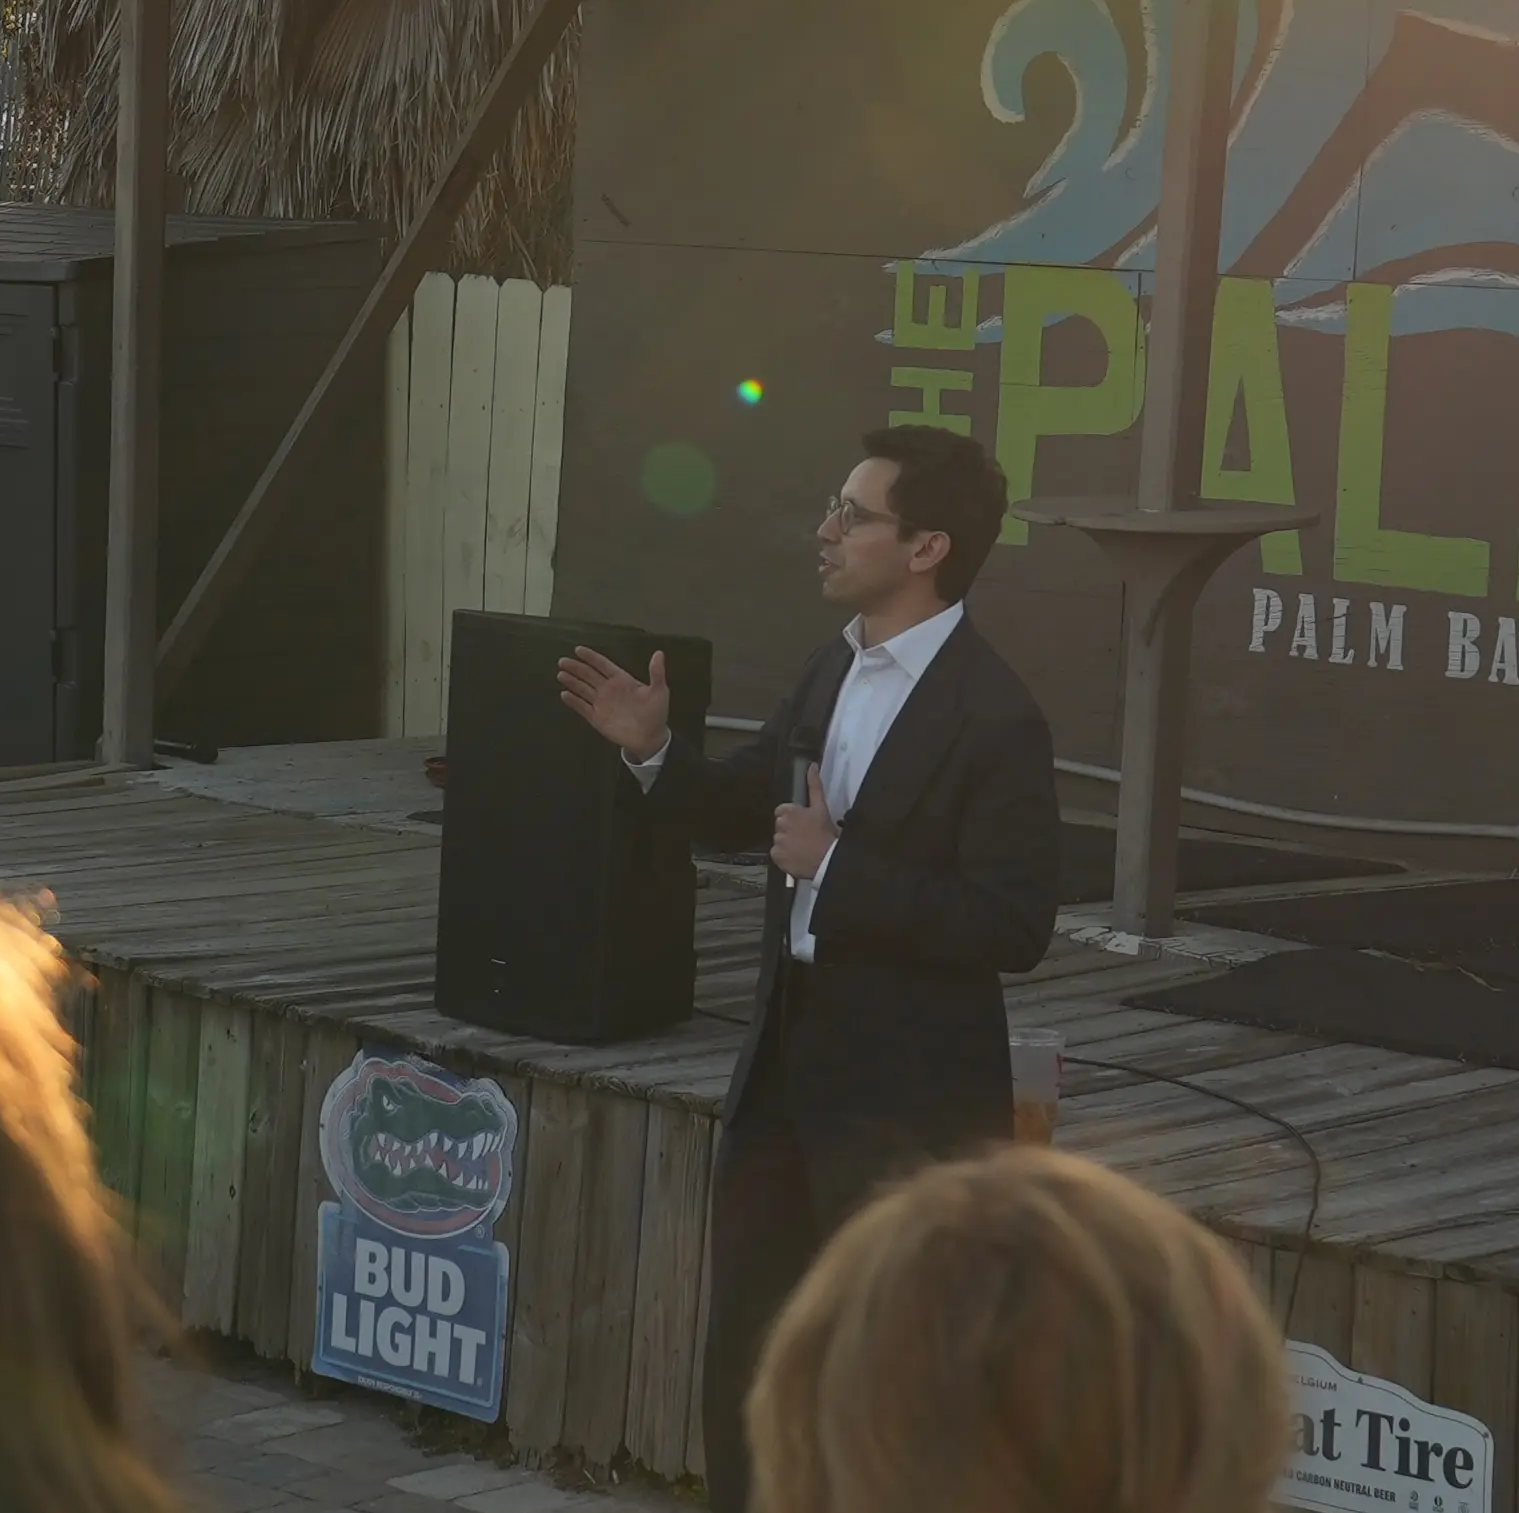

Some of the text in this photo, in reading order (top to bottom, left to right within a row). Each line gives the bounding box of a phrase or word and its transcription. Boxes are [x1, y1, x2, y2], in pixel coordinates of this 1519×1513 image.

[888, 259, 980, 434] HE
[1248, 587, 1408, 672] PALM
[353, 1237, 466, 1316] BUD
[329, 1292, 487, 1385] LIGHT
[1294, 1374, 1338, 1392] LGIUM
[1290, 1407, 1475, 1490] at Tire
[1296, 1469, 1332, 1488] CARBON
[1333, 1477, 1372, 1497] NEUTRAL
[1374, 1486, 1397, 1503] BEER
